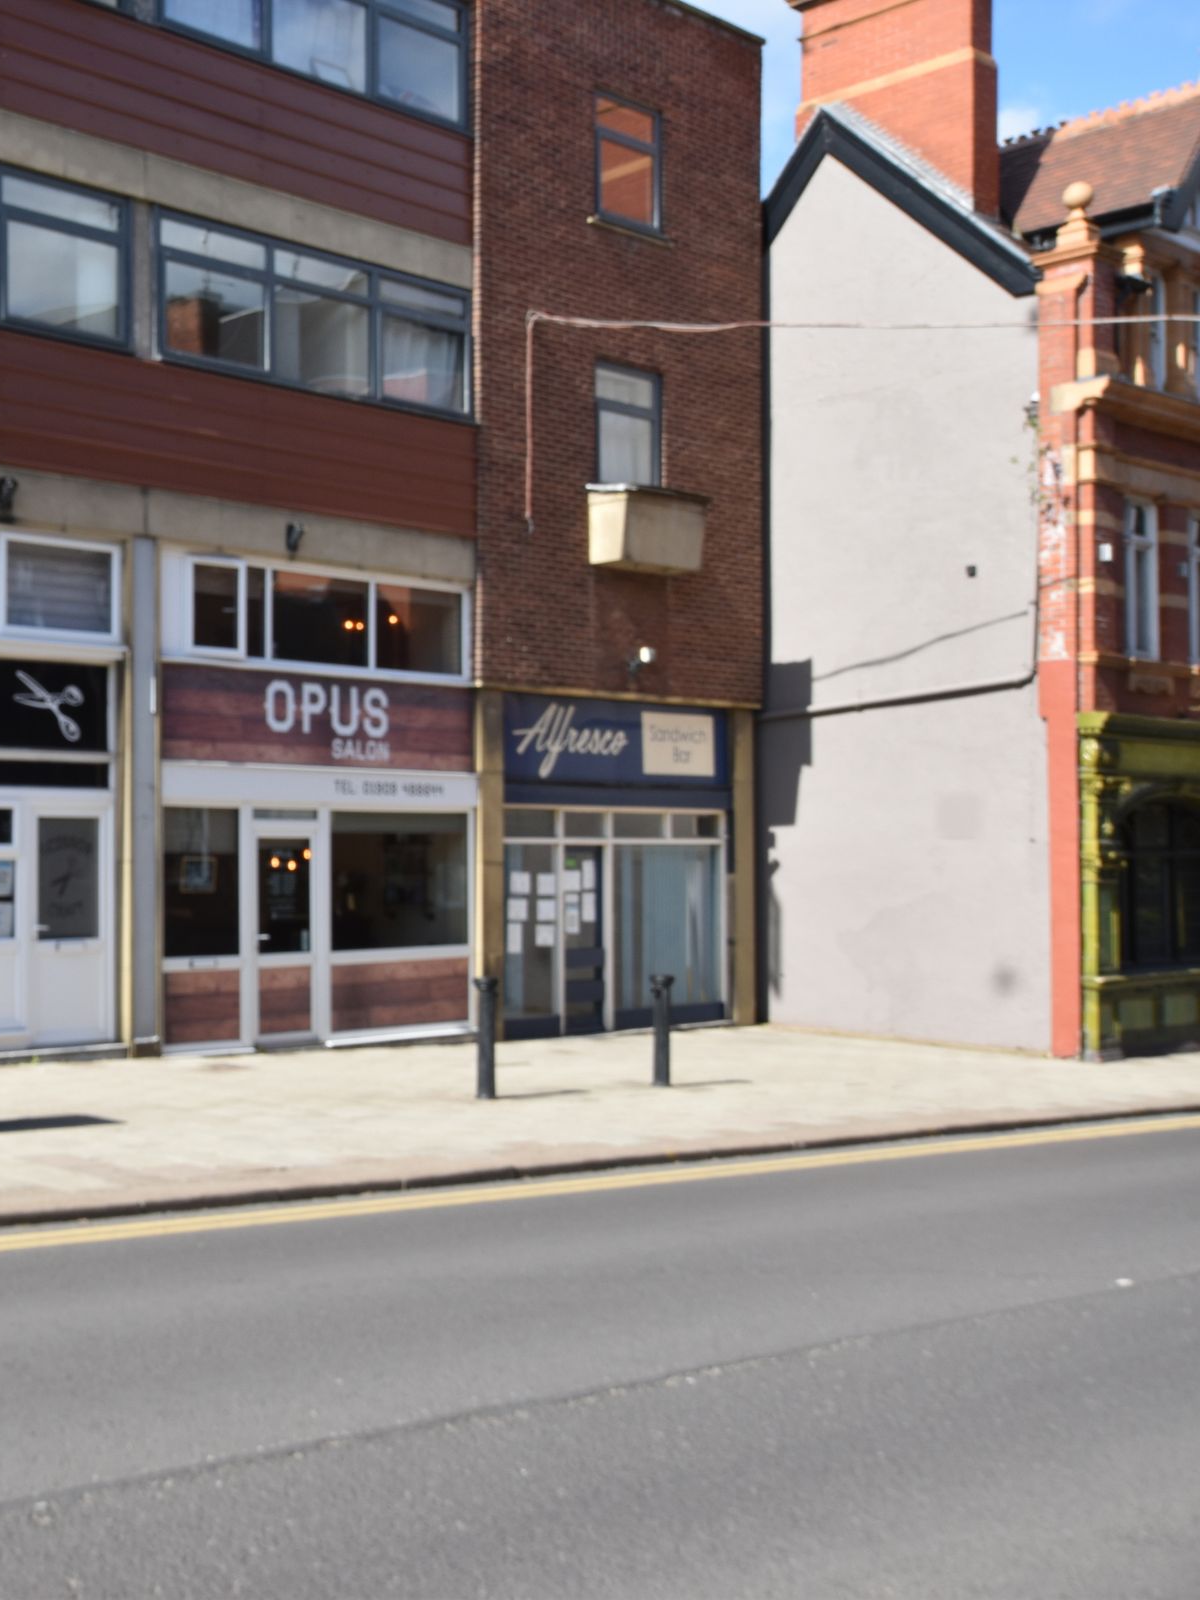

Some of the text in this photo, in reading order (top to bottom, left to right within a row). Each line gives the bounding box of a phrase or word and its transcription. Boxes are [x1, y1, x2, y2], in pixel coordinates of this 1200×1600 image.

[265, 678, 389, 738] OPUS
[511, 703, 628, 779] Alfresco
[649, 723, 706, 744] Sandwich
[331, 736, 390, 762] SALON
[672, 745, 691, 764] Bar
